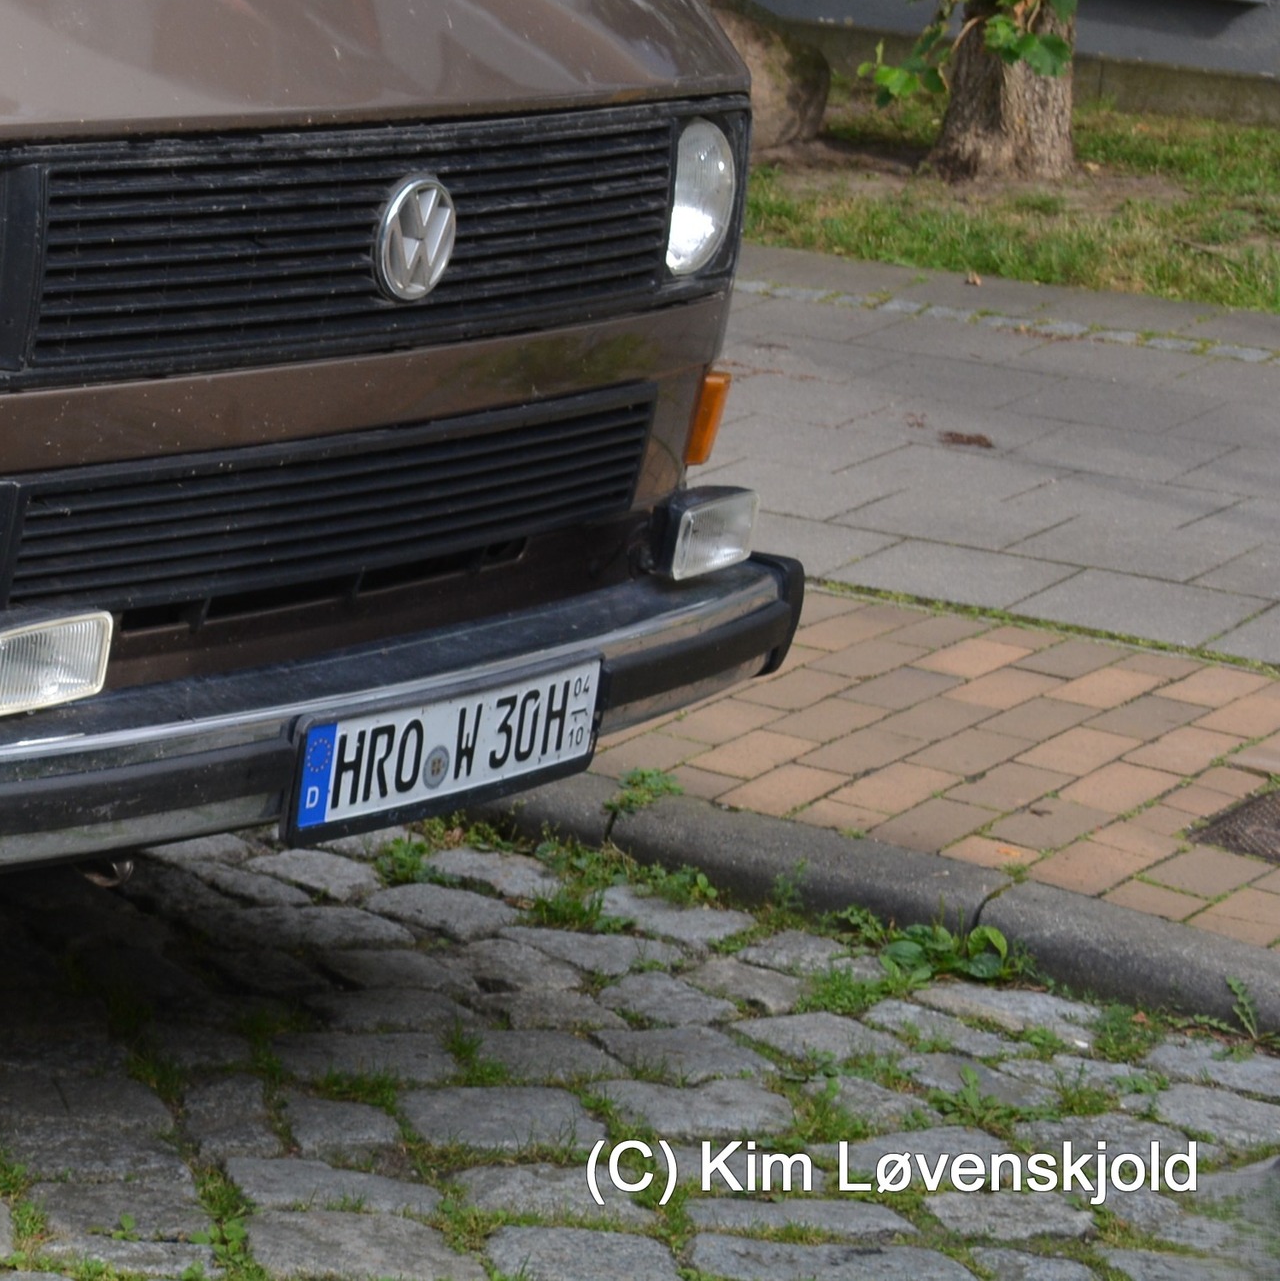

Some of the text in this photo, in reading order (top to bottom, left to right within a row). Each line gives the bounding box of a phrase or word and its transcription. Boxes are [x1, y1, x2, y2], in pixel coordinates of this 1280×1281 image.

[573, 675, 590, 698] 04
[305, 680, 571, 810] D HRO W 30H
[568, 725, 584, 749] 10
